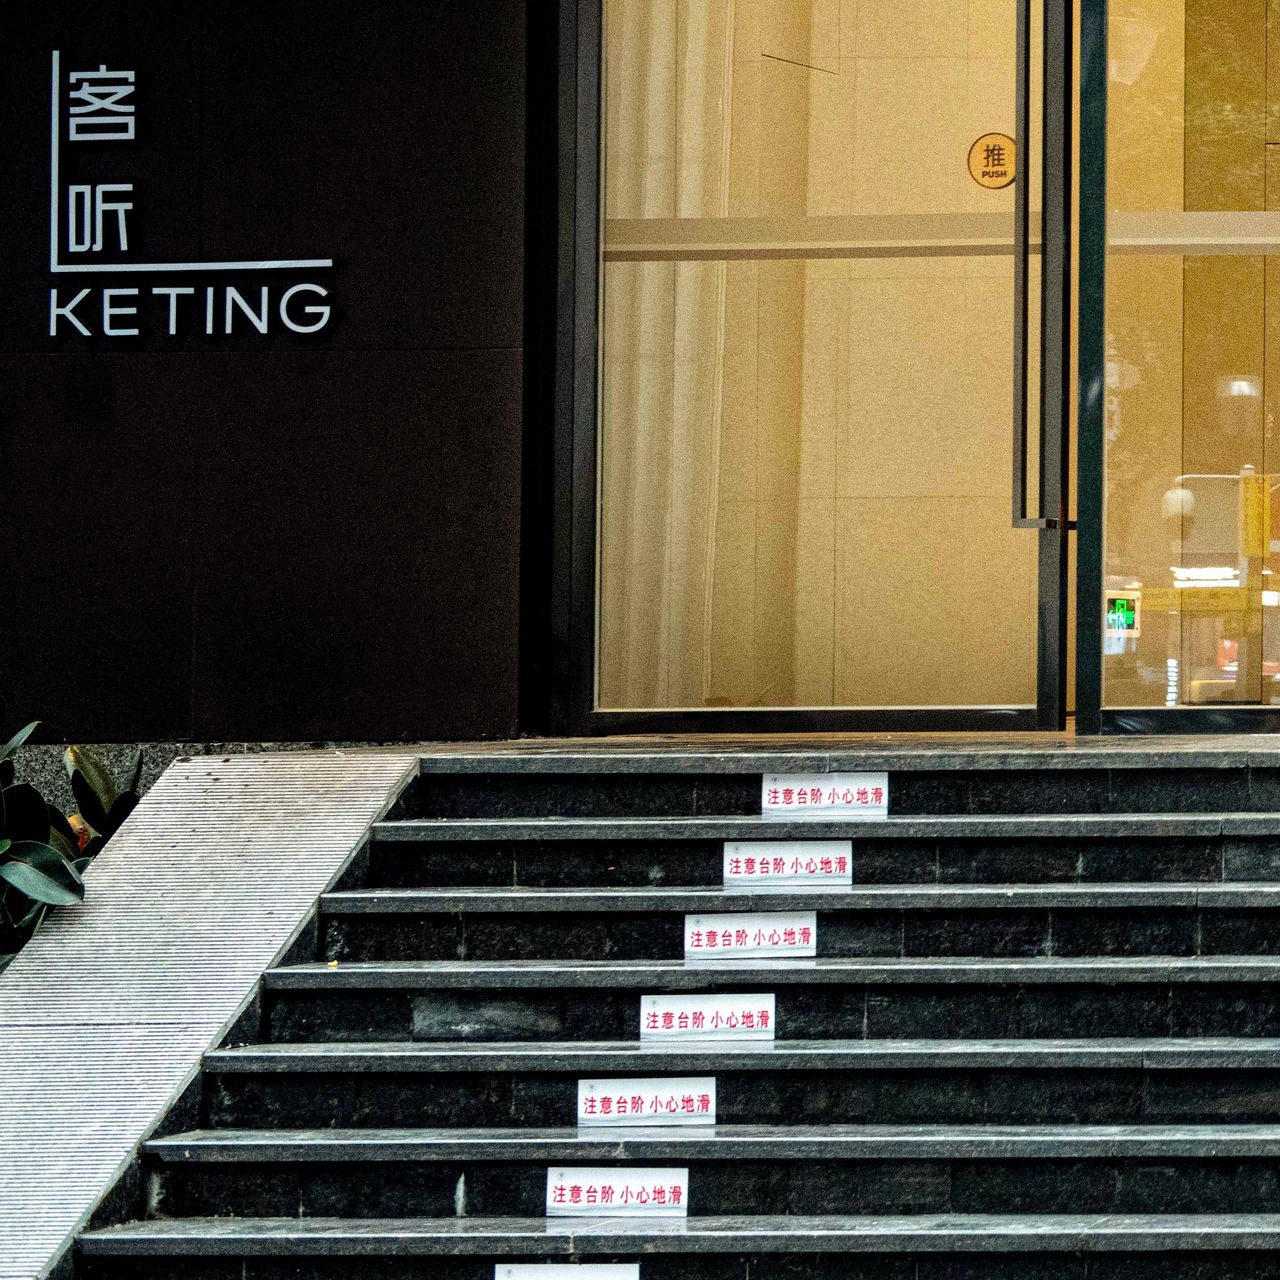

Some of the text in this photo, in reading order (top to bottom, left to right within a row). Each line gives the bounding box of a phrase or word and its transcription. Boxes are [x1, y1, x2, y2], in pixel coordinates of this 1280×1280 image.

[68, 64, 136, 253] 客听
[984, 144, 1005, 167] 推
[982, 170, 1006, 178] PUSH
[49, 283, 332, 337] KETING
[768, 787, 884, 805] 注意台阶 小心地滑
[729, 856, 847, 875] 注意台阶 小心地滑
[690, 927, 811, 948] 注意台阶 小心地滑
[646, 1009, 770, 1030] 注意台阶 小心地滑
[584, 1093, 711, 1115] 注意台阶 小心地滑
[553, 1184, 683, 1205] 注意台阶 小心地滑
